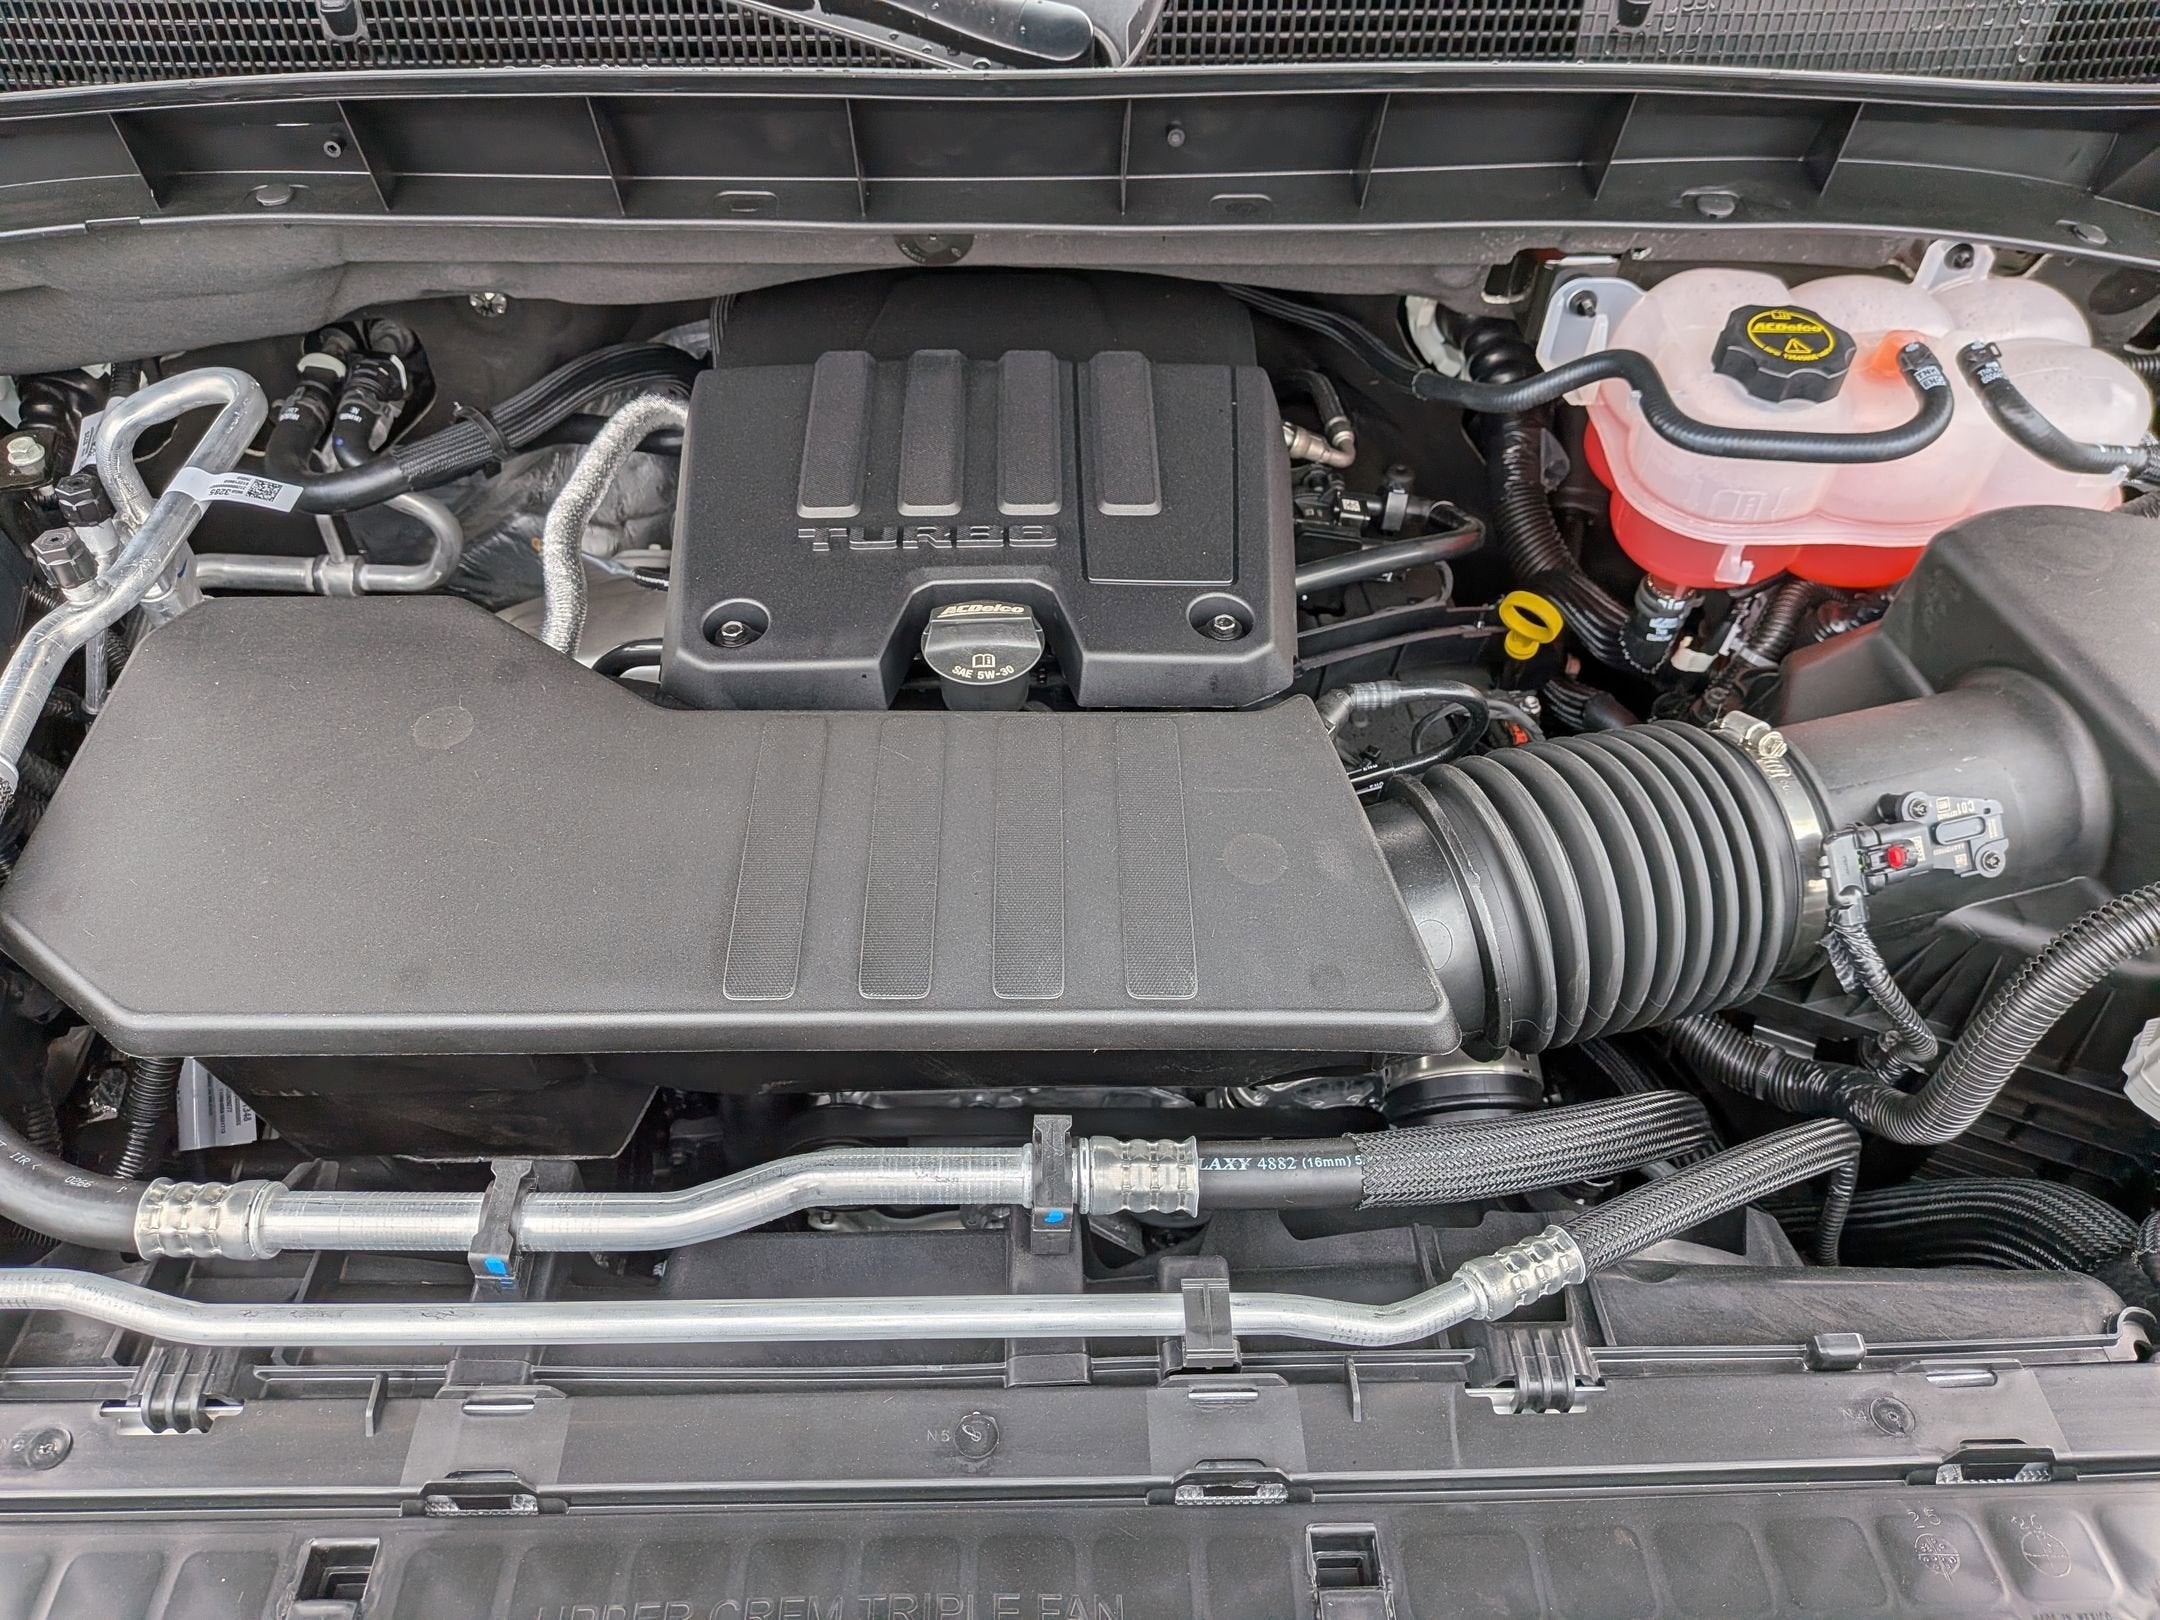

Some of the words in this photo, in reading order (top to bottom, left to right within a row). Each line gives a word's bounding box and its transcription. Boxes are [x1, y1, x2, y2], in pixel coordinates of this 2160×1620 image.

[1752, 322, 1822, 333] ACDelco
[208, 488, 231, 496] 3285
[798, 526, 1057, 551] TURBO
[940, 603, 1025, 617] ACDelco
[951, 664, 974, 679] SAE
[977, 665, 1015, 680] 5W-30
[1257, 1157, 1297, 1170] 4882
[1302, 1157, 1352, 1170] (16mm)
[64, 1175, 94, 1188] 0266
[927, 1429, 950, 1441] N5
[1036, 1592, 1124, 1620] FAN
